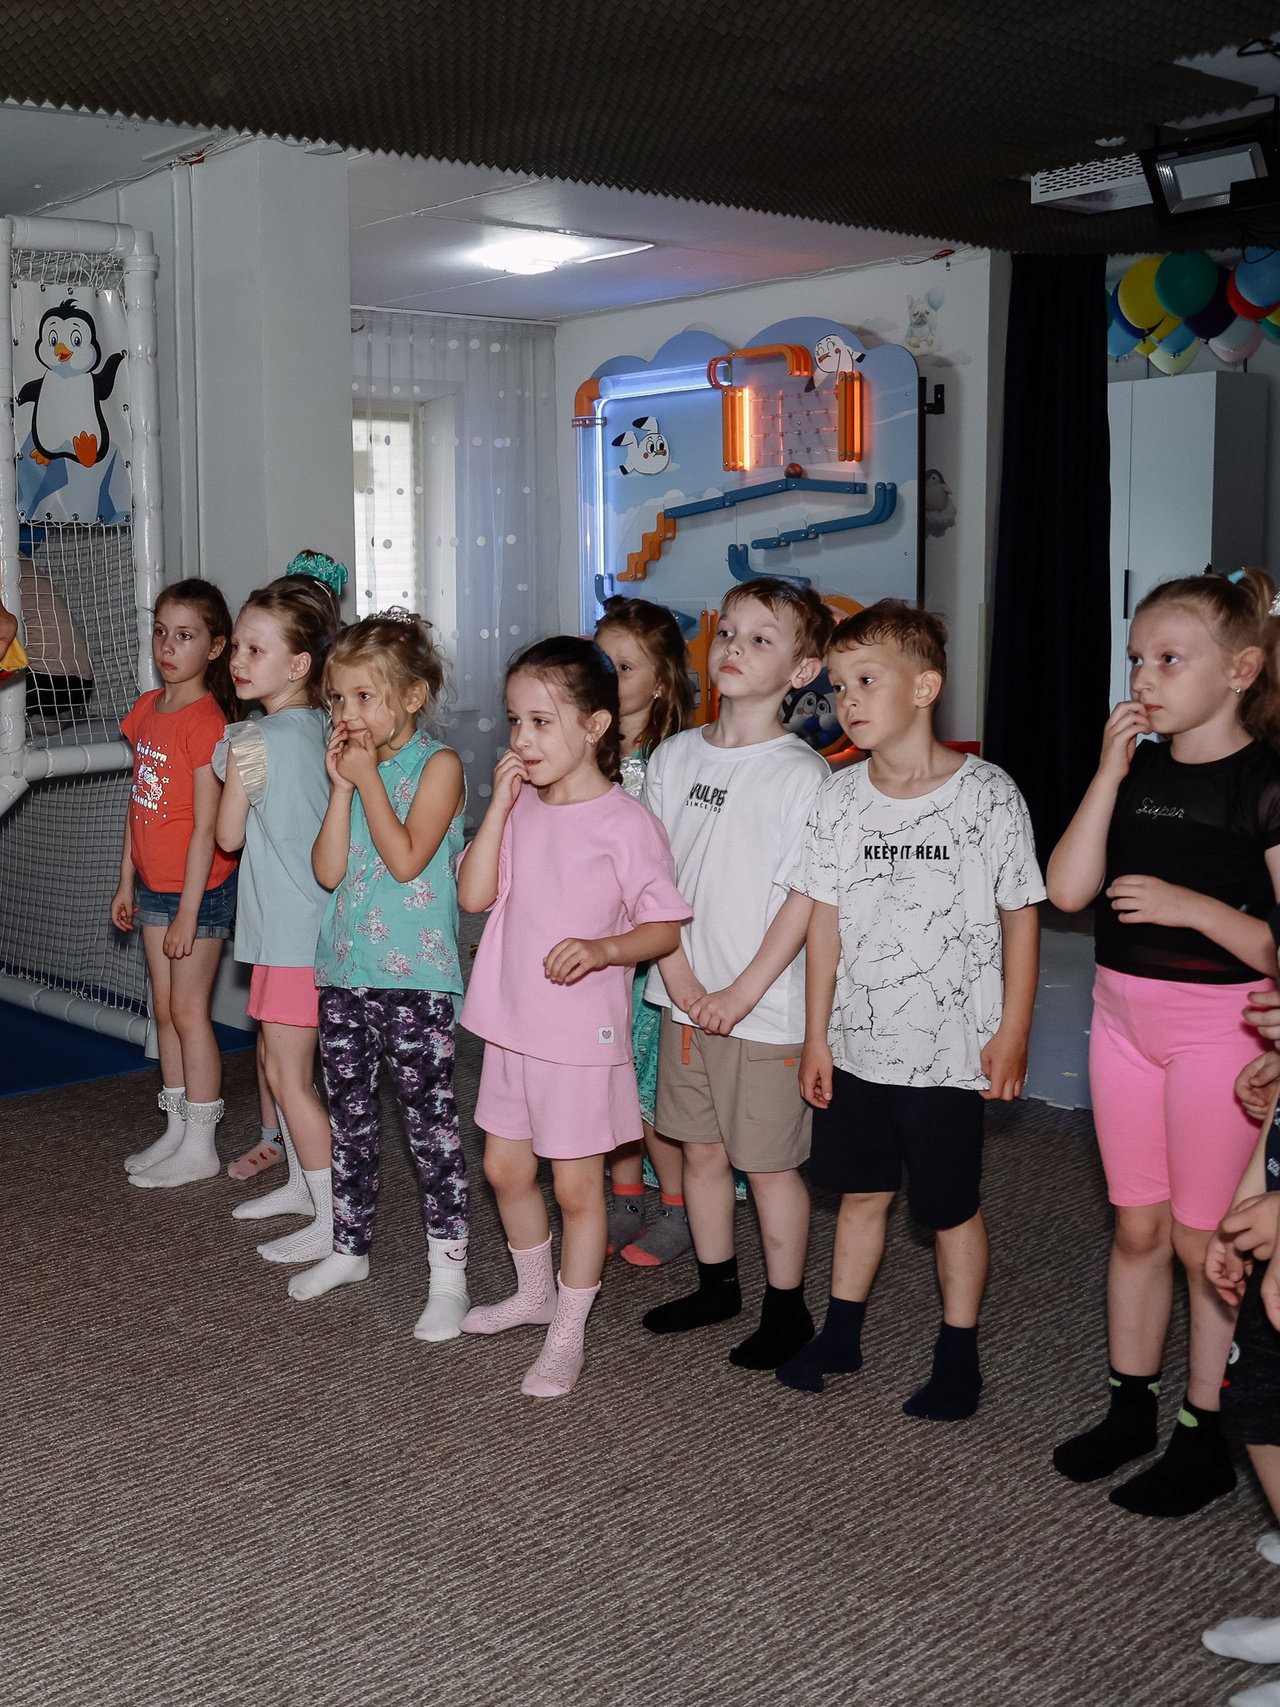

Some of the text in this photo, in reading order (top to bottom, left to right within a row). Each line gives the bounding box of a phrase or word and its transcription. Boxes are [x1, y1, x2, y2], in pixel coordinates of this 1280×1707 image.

[864, 845, 950, 860] KEEP IT REAL
